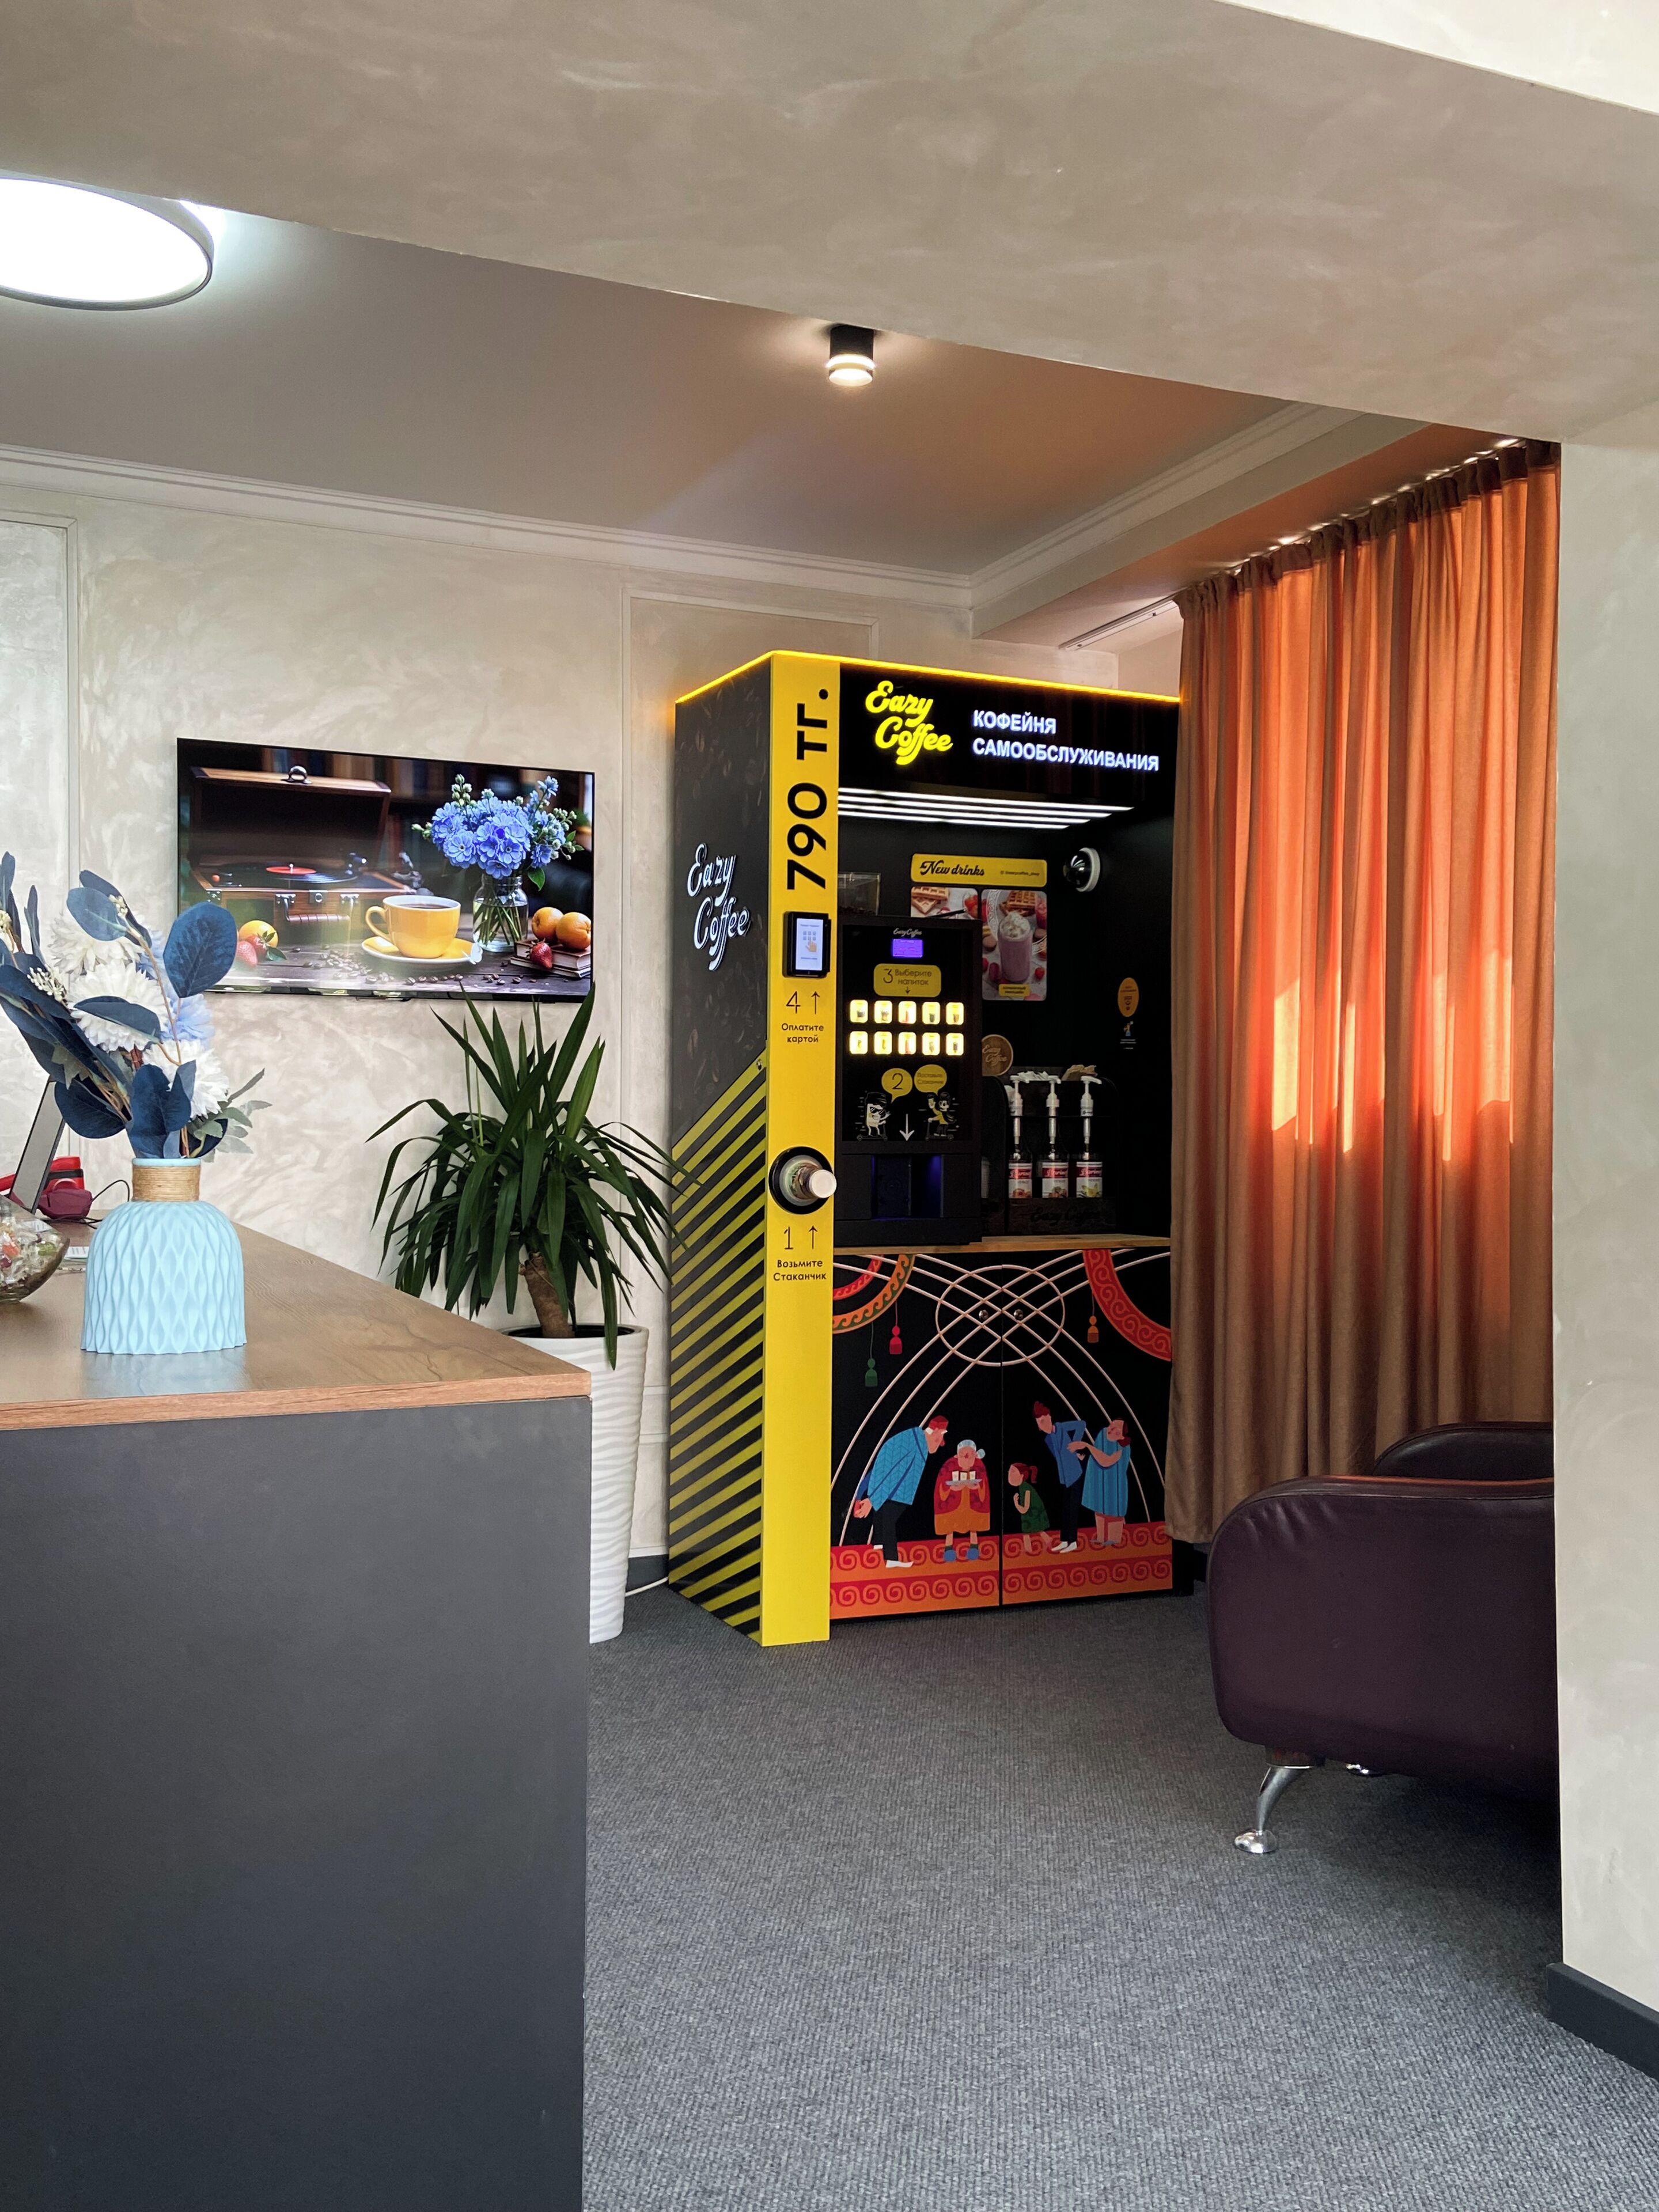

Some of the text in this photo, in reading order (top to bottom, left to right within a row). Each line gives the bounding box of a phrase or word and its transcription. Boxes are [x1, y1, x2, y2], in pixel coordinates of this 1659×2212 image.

[865, 680, 933, 726] Eazy
[974, 710, 1056, 734] КОФЕЙНЯ
[874, 716, 953, 765] Coffee
[972, 738, 1160, 771] САМООБСЛУЖИВАНИЯ
[786, 782, 827, 890] 790
[687, 843, 737, 907] Eazy
[920, 859, 950, 876] New
[951, 864, 985, 876] drinks
[694, 896, 751, 971] Coffee
[883, 968, 893, 983] 3
[895, 968, 932, 978] Выберите
[786, 991, 801, 1014] 4
[781, 1022, 824, 1032] Оплатите
[787, 1034, 819, 1044] картой
[892, 1073, 904, 1090] 2
[784, 1226, 793, 1249] 1
[777, 1259, 823, 1268] Возьмите
[773, 1271, 827, 1281] Стаканчик
